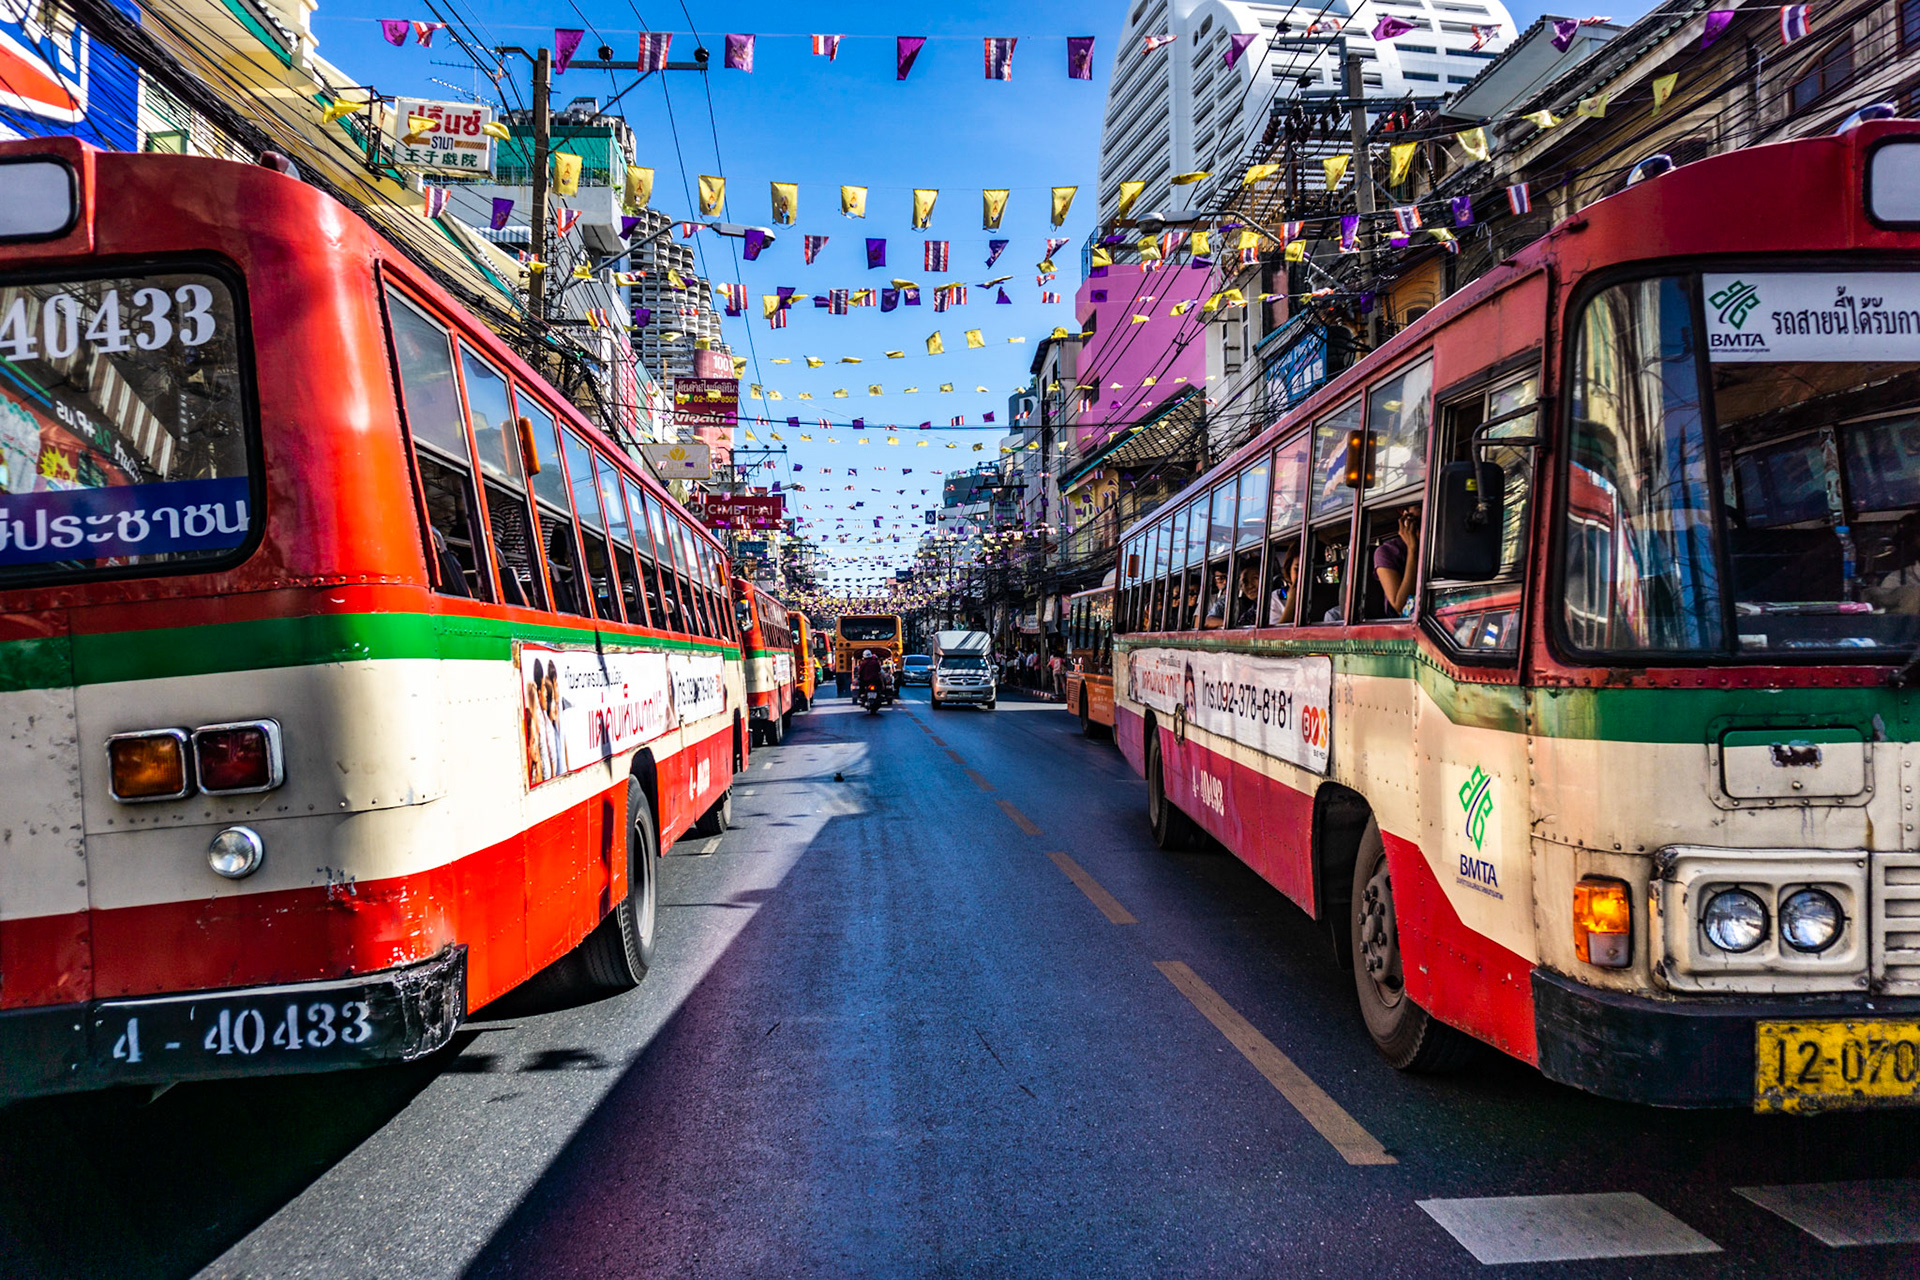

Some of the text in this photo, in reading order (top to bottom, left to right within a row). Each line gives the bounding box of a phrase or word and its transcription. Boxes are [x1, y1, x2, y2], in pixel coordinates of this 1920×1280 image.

[431, 136, 453, 150] รามา
[0, 284, 216, 361] 40433
[1711, 334, 1765, 347] BMTA
[1460, 854, 1498, 888] BMTA
[113, 1018, 143, 1063] 4
[204, 1001, 373, 1055] 40433
